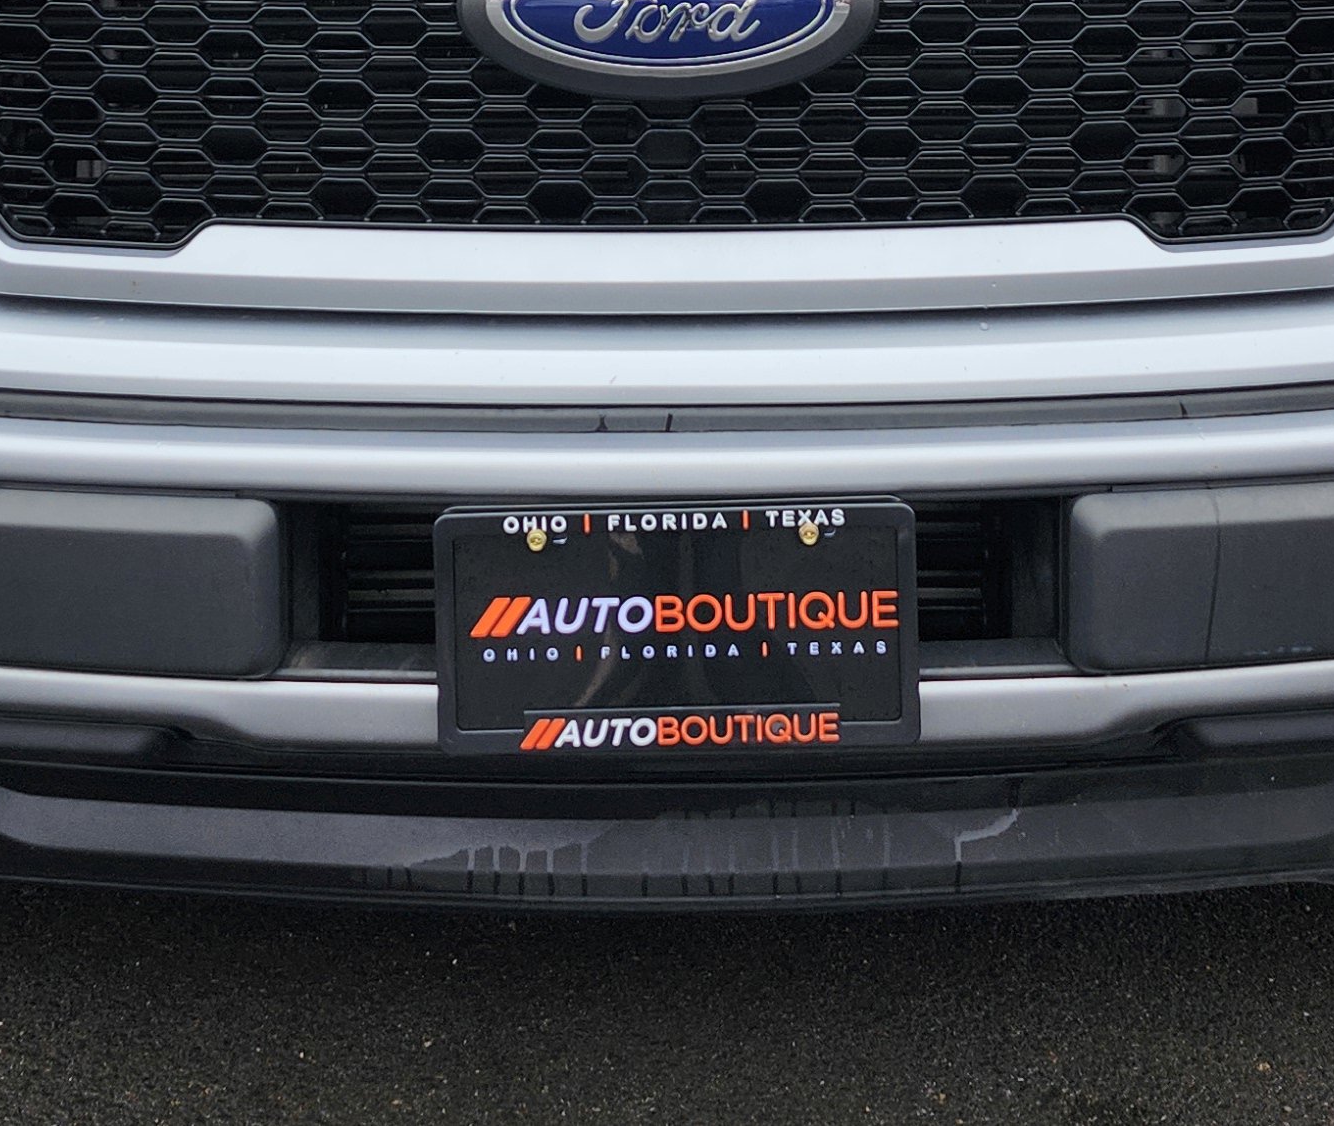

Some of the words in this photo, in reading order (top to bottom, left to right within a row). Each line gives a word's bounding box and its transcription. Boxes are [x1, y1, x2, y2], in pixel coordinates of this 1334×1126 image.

[502, 514, 568, 535] OHIO
[607, 512, 727, 532] FLORIDA
[766, 509, 846, 528] TEXAS
[516, 590, 899, 635] AUTOBOUTIQUE
[482, 647, 560, 663] OHIO
[600, 643, 740, 661] FLORIDA
[786, 640, 887, 656] TEXAS
[554, 712, 841, 748] AUTOBOUTIQUE
